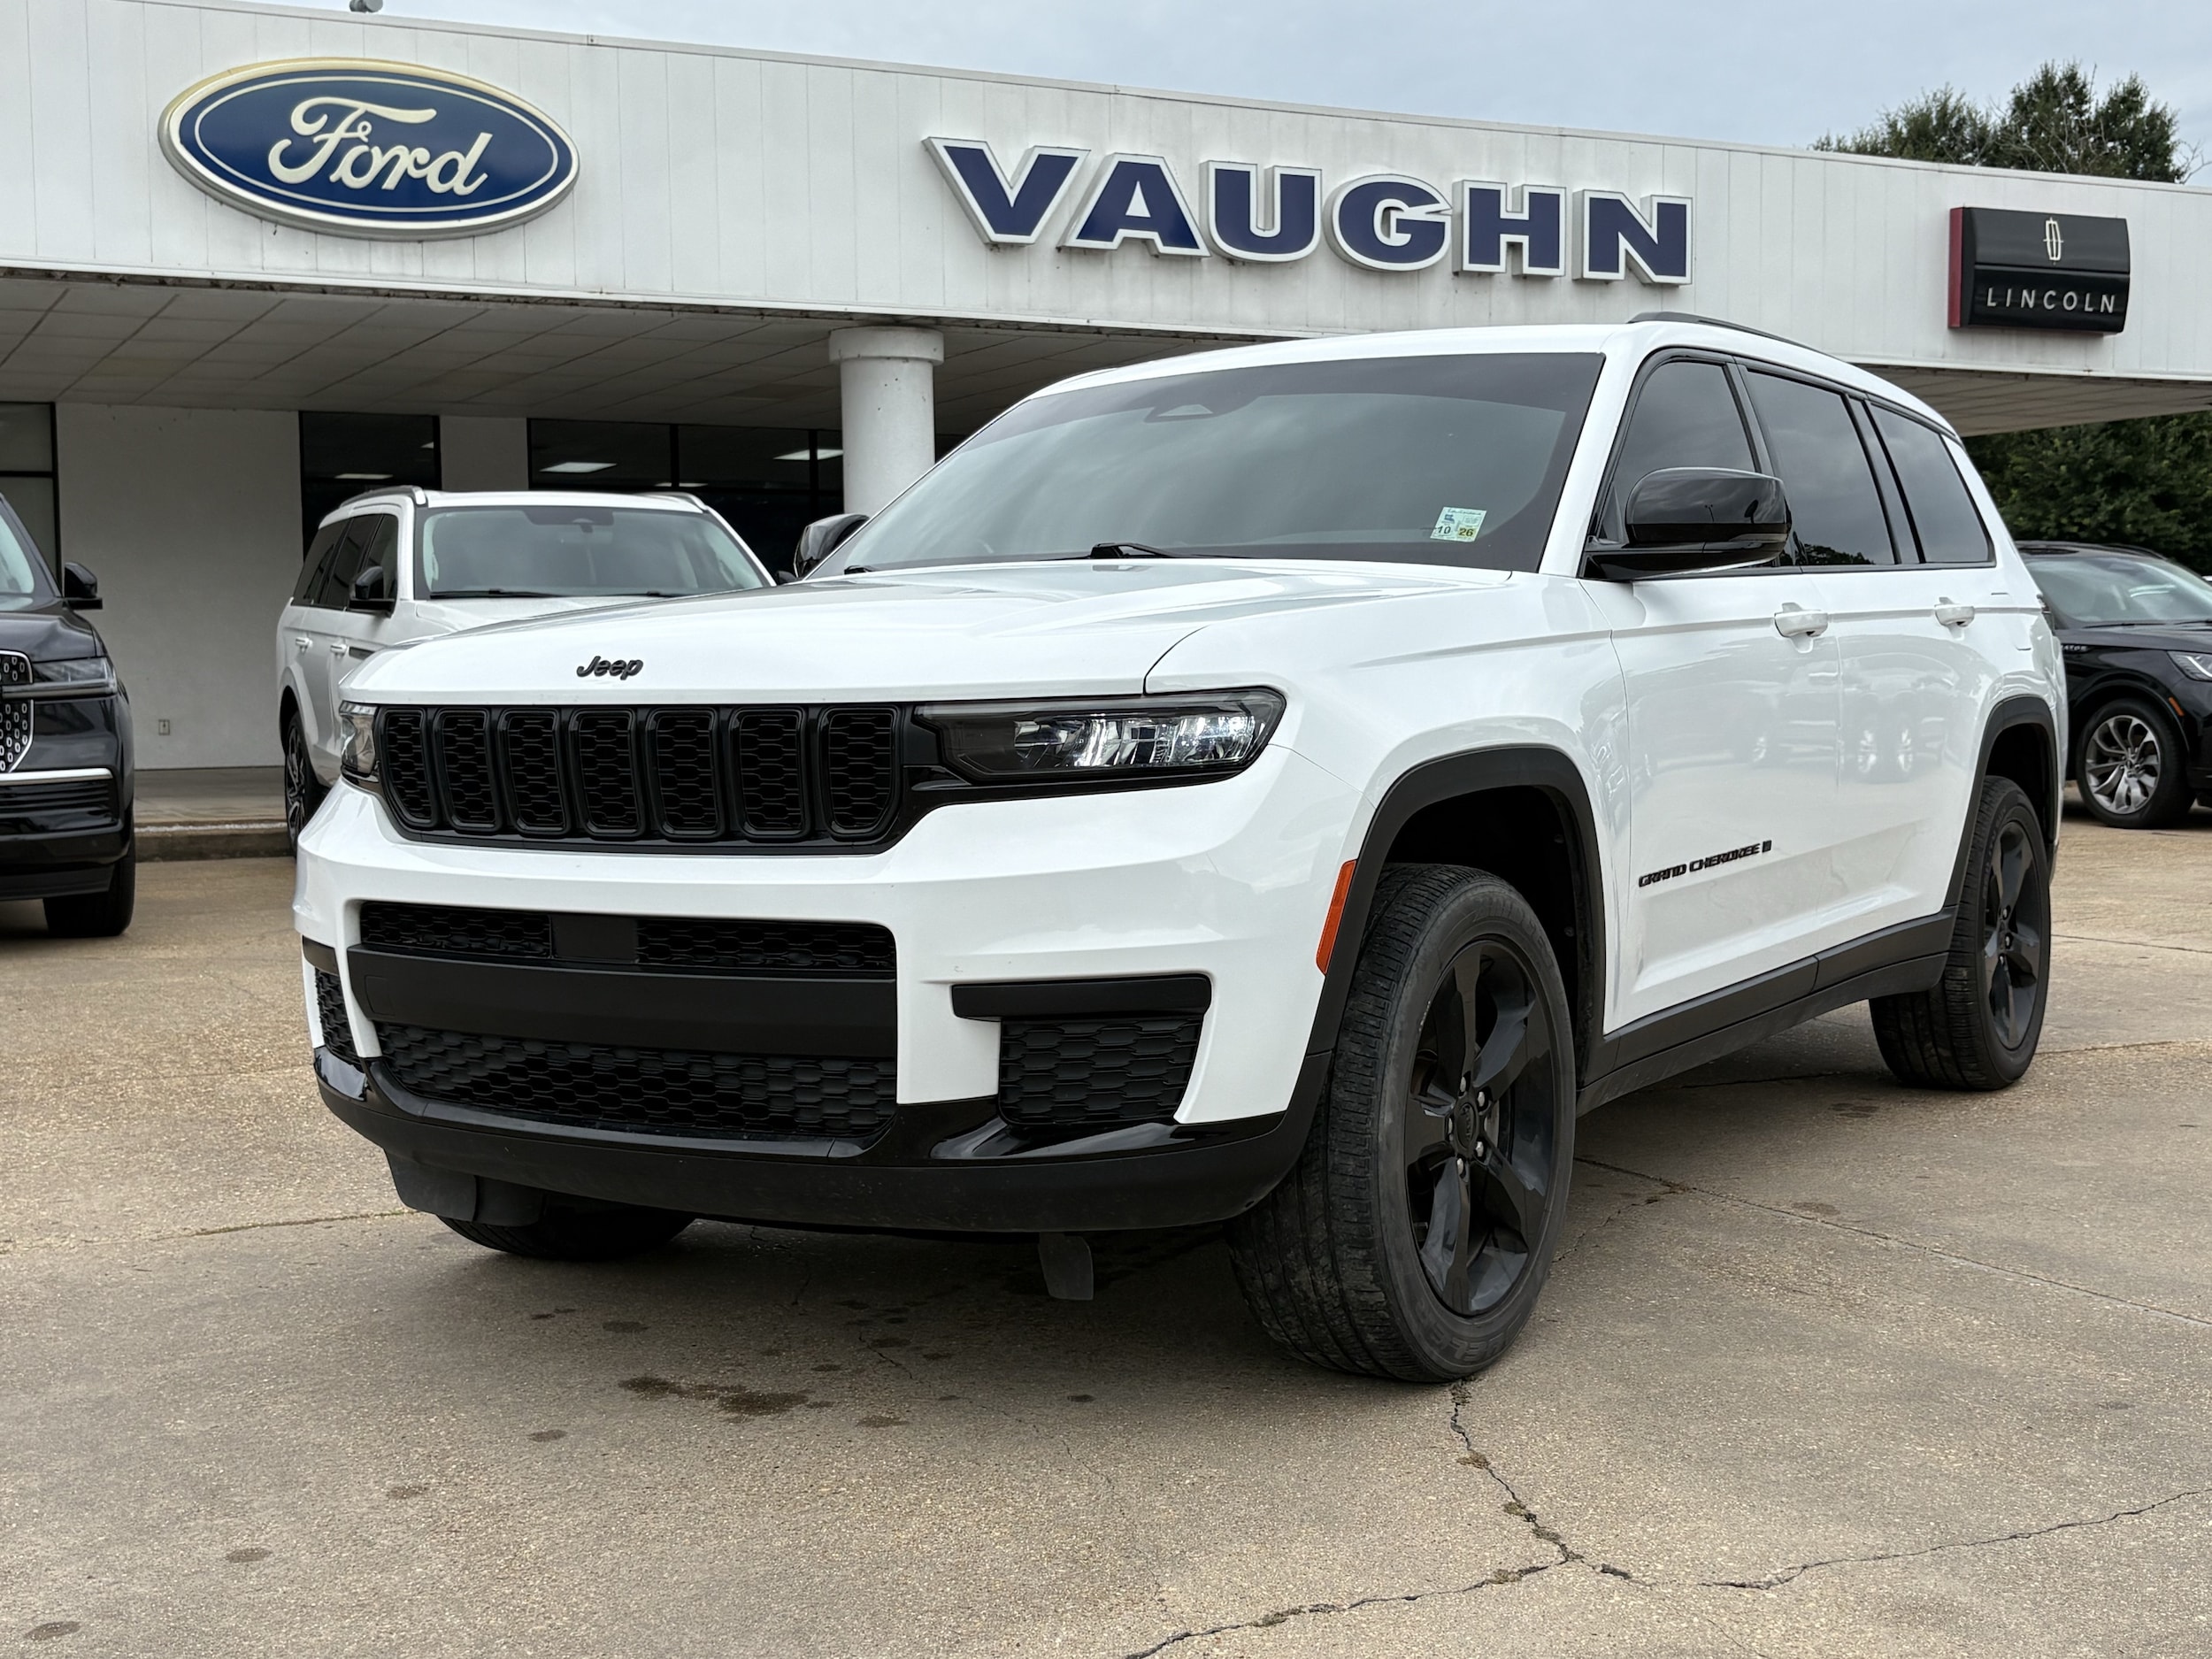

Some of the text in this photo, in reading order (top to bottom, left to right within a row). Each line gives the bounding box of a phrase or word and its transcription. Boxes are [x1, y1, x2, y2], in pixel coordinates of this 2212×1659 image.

[268, 96, 493, 196] Ford
[922, 136, 1694, 285] VAUGHN
[1986, 288, 2116, 313] LINCOLN
[1438, 526, 1474, 537] 10 26
[576, 656, 643, 680] Jeep
[1639, 864, 1687, 887] GRAND
[1689, 843, 1761, 872] CHEROKEE
